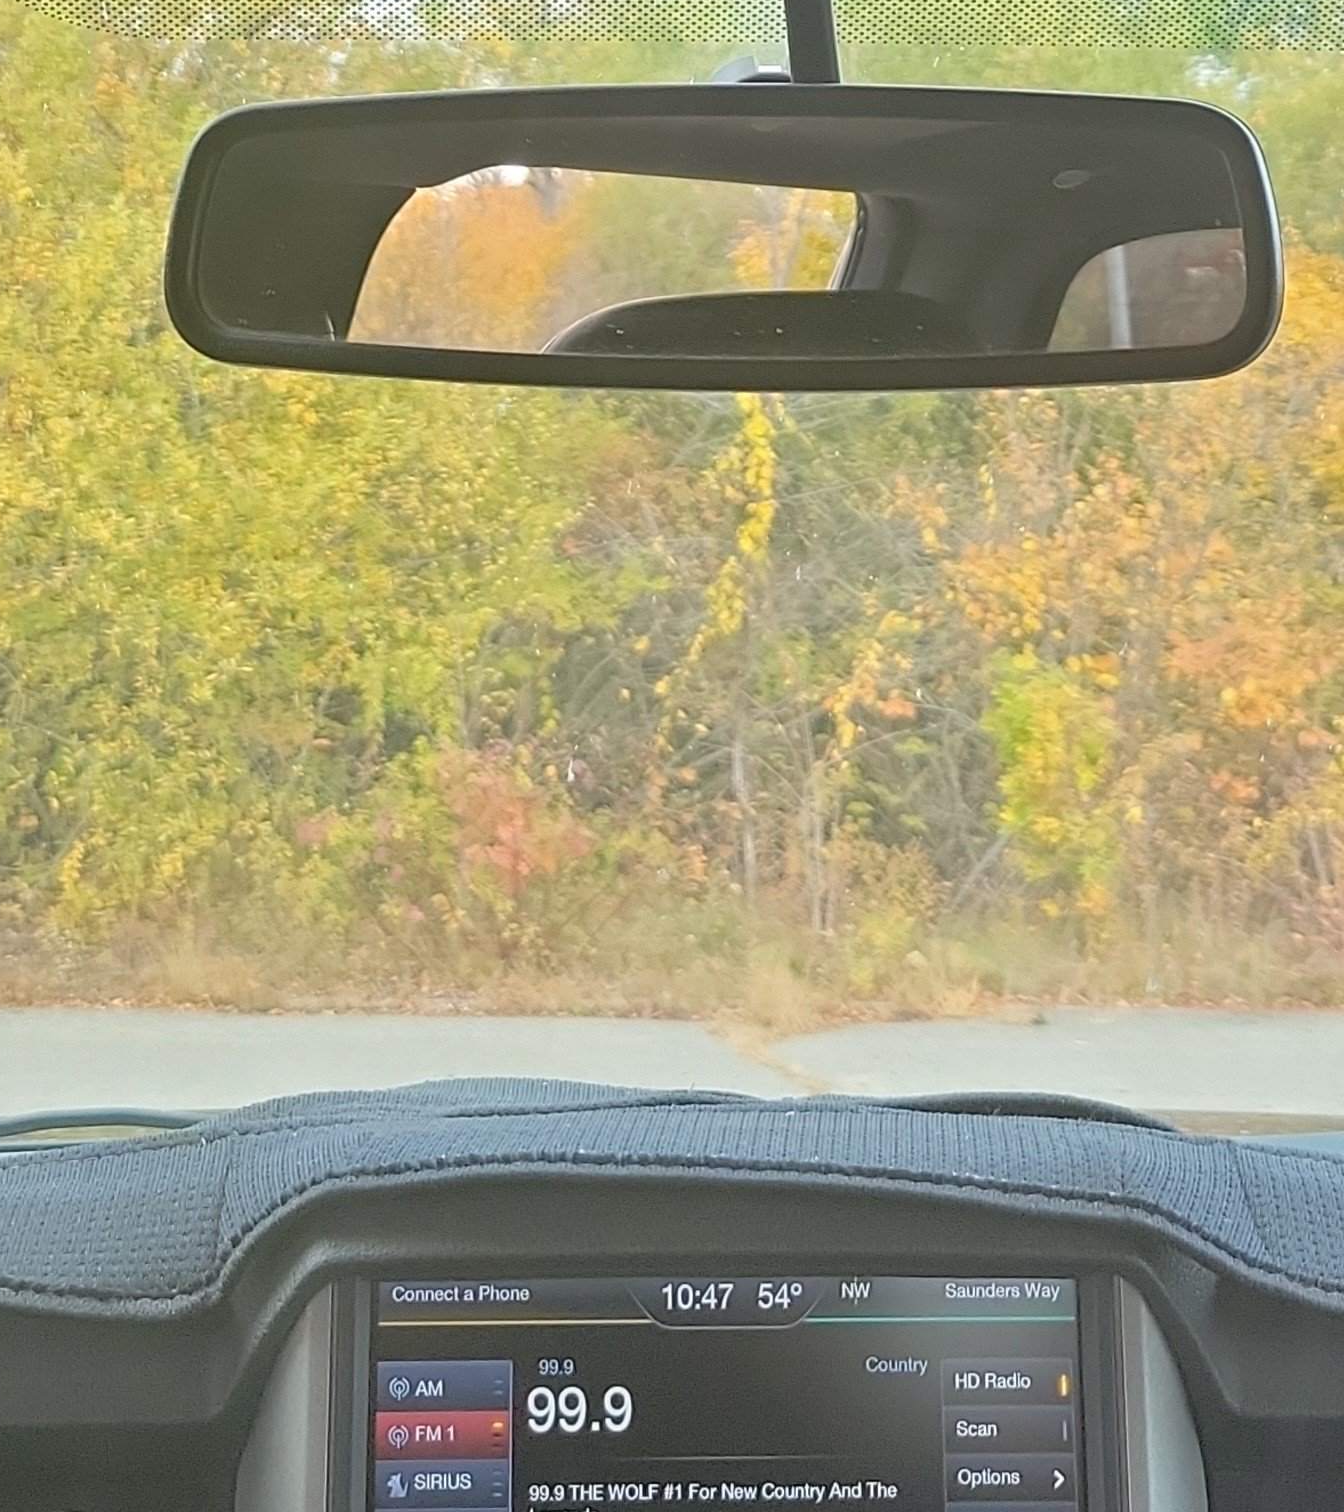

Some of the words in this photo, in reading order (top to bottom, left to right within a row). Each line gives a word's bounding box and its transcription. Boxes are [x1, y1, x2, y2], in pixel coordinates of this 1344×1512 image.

[391, 1284, 460, 1303] Connect
[462, 1290, 475, 1303] a
[477, 1284, 531, 1303] Phone
[661, 1283, 735, 1311] 10:47
[840, 1282, 872, 1300] NW
[944, 1282, 1022, 1300] Saunders
[1025, 1282, 1061, 1303] Way
[538, 1358, 575, 1376] 99.9
[864, 1356, 929, 1376] Country
[414, 1379, 444, 1398] AM
[954, 1372, 981, 1389] HD
[983, 1372, 1032, 1390] Radio
[526, 1385, 635, 1434] 99.9
[414, 1425, 443, 1443] FM
[447, 1424, 455, 1442] 1
[955, 1420, 999, 1438] Scan
[413, 1473, 473, 1492] SIRIUS
[957, 1467, 1021, 1487] Options
[527, 1483, 566, 1503] 99.9
[567, 1484, 605, 1502] THE
[607, 1483, 660, 1502] WOLF
[663, 1482, 684, 1501] #1
[688, 1482, 718, 1501] For
[720, 1482, 758, 1501] New
[761, 1481, 826, 1505] Country
[828, 1481, 863, 1501] And
[865, 1480, 899, 1500] The
